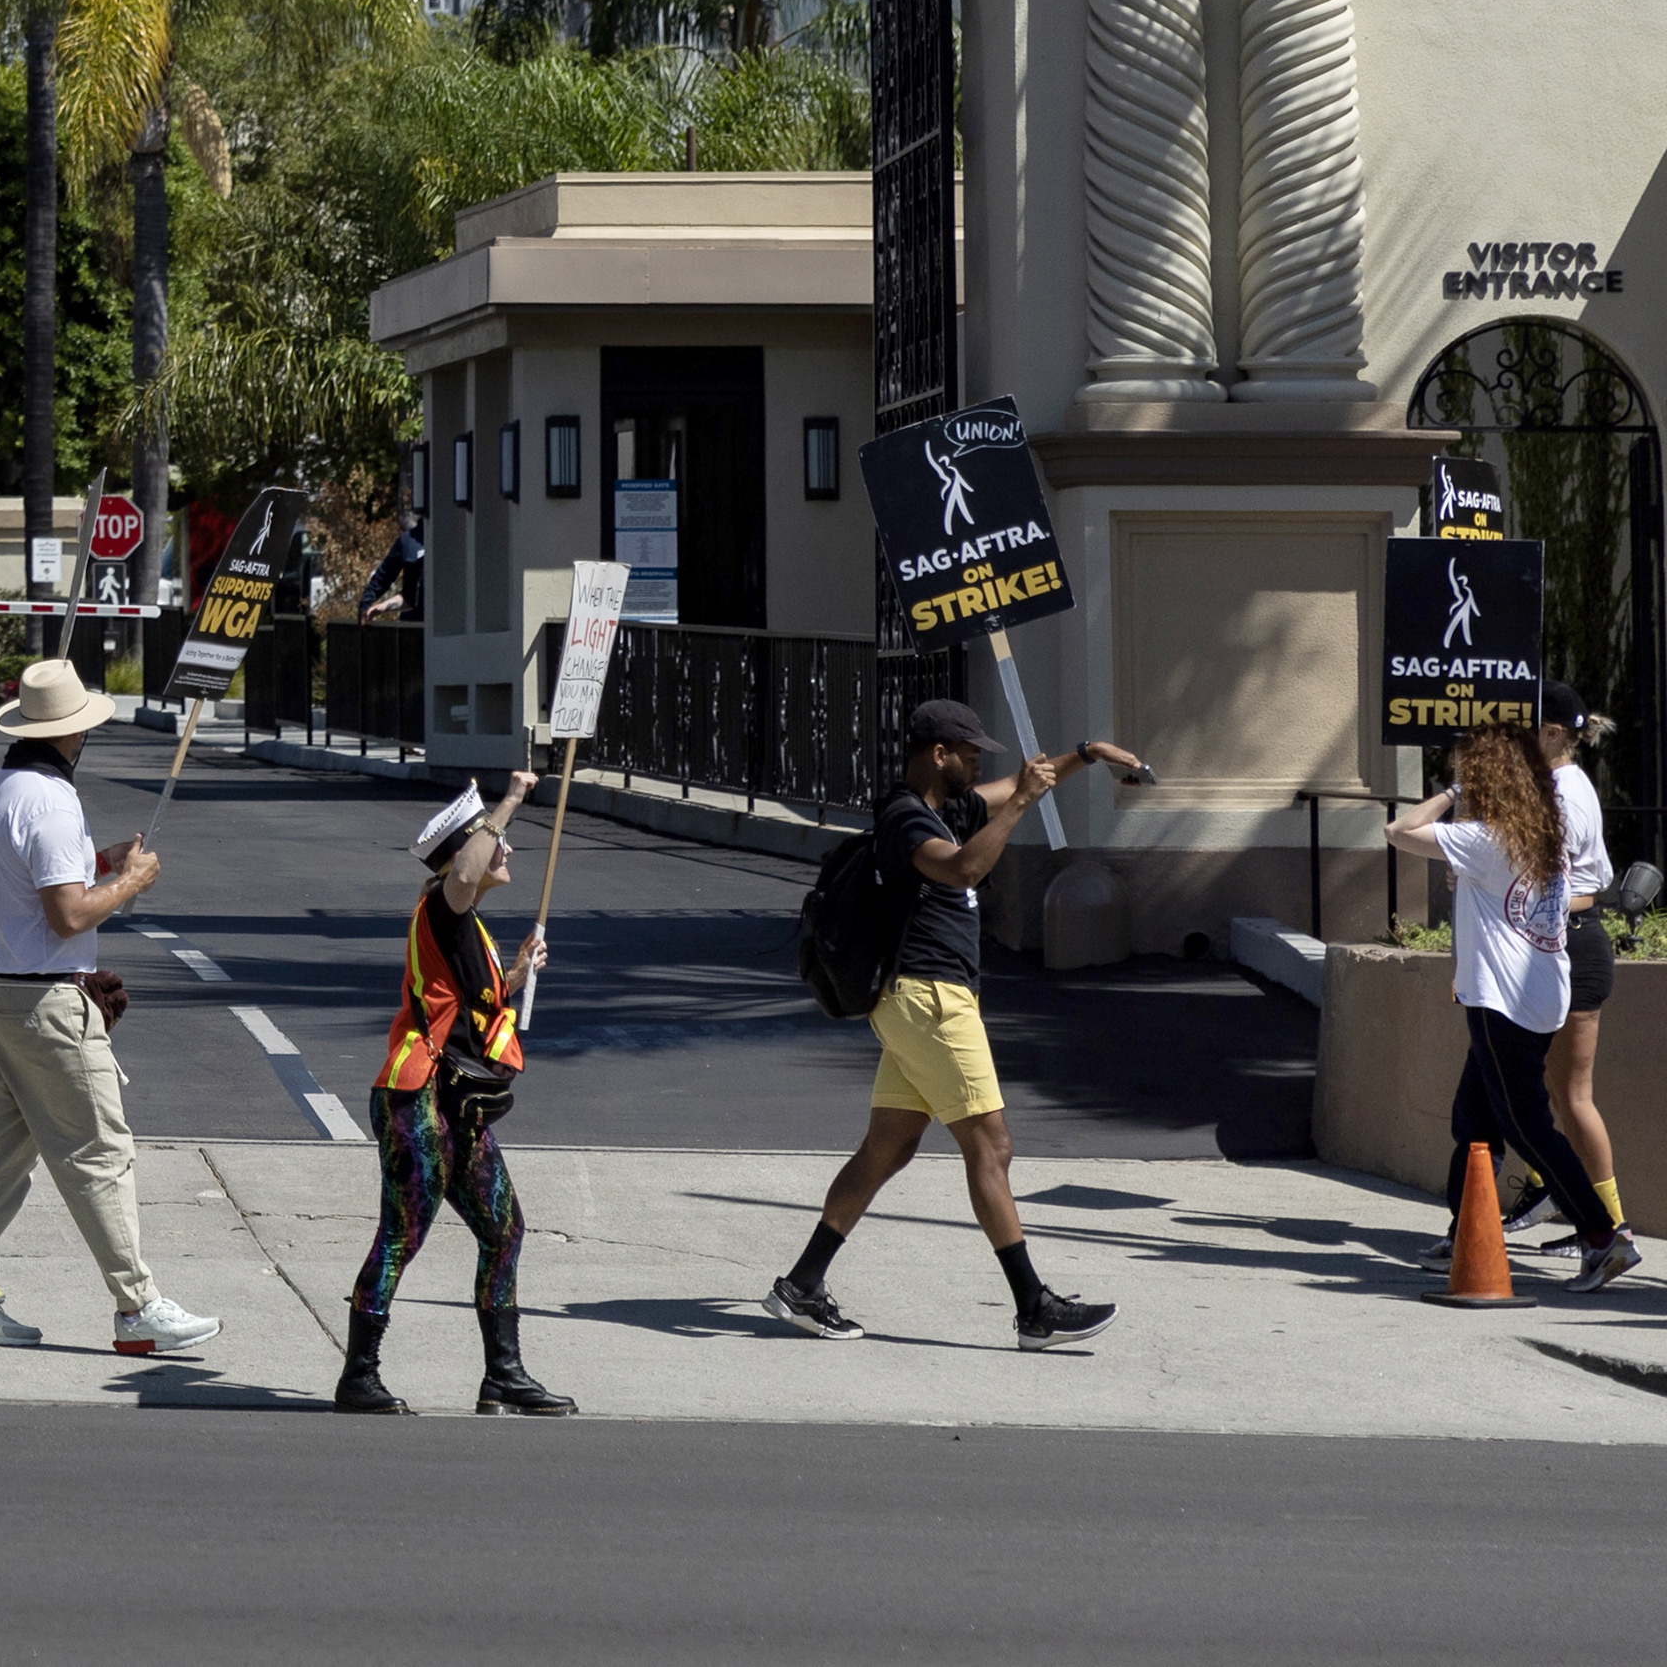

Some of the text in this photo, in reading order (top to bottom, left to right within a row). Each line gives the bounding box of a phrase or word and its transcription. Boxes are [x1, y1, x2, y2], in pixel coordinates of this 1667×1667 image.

[1468, 242, 1597, 271] VISITOR
[1444, 270, 1624, 299] ENTRANCE
[955, 420, 1022, 442] UNION!
[93, 515, 139, 539] TOP
[1473, 512, 1488, 528] ON
[961, 562, 994, 585] ON
[210, 575, 275, 601] SUPPORTS
[910, 561, 1062, 632] STRIKE!
[198, 596, 262, 639] WGA
[1446, 682, 1475, 699] ON
[1389, 698, 1533, 729] STRIKE!
[1510, 889, 1525, 923] SACHS
